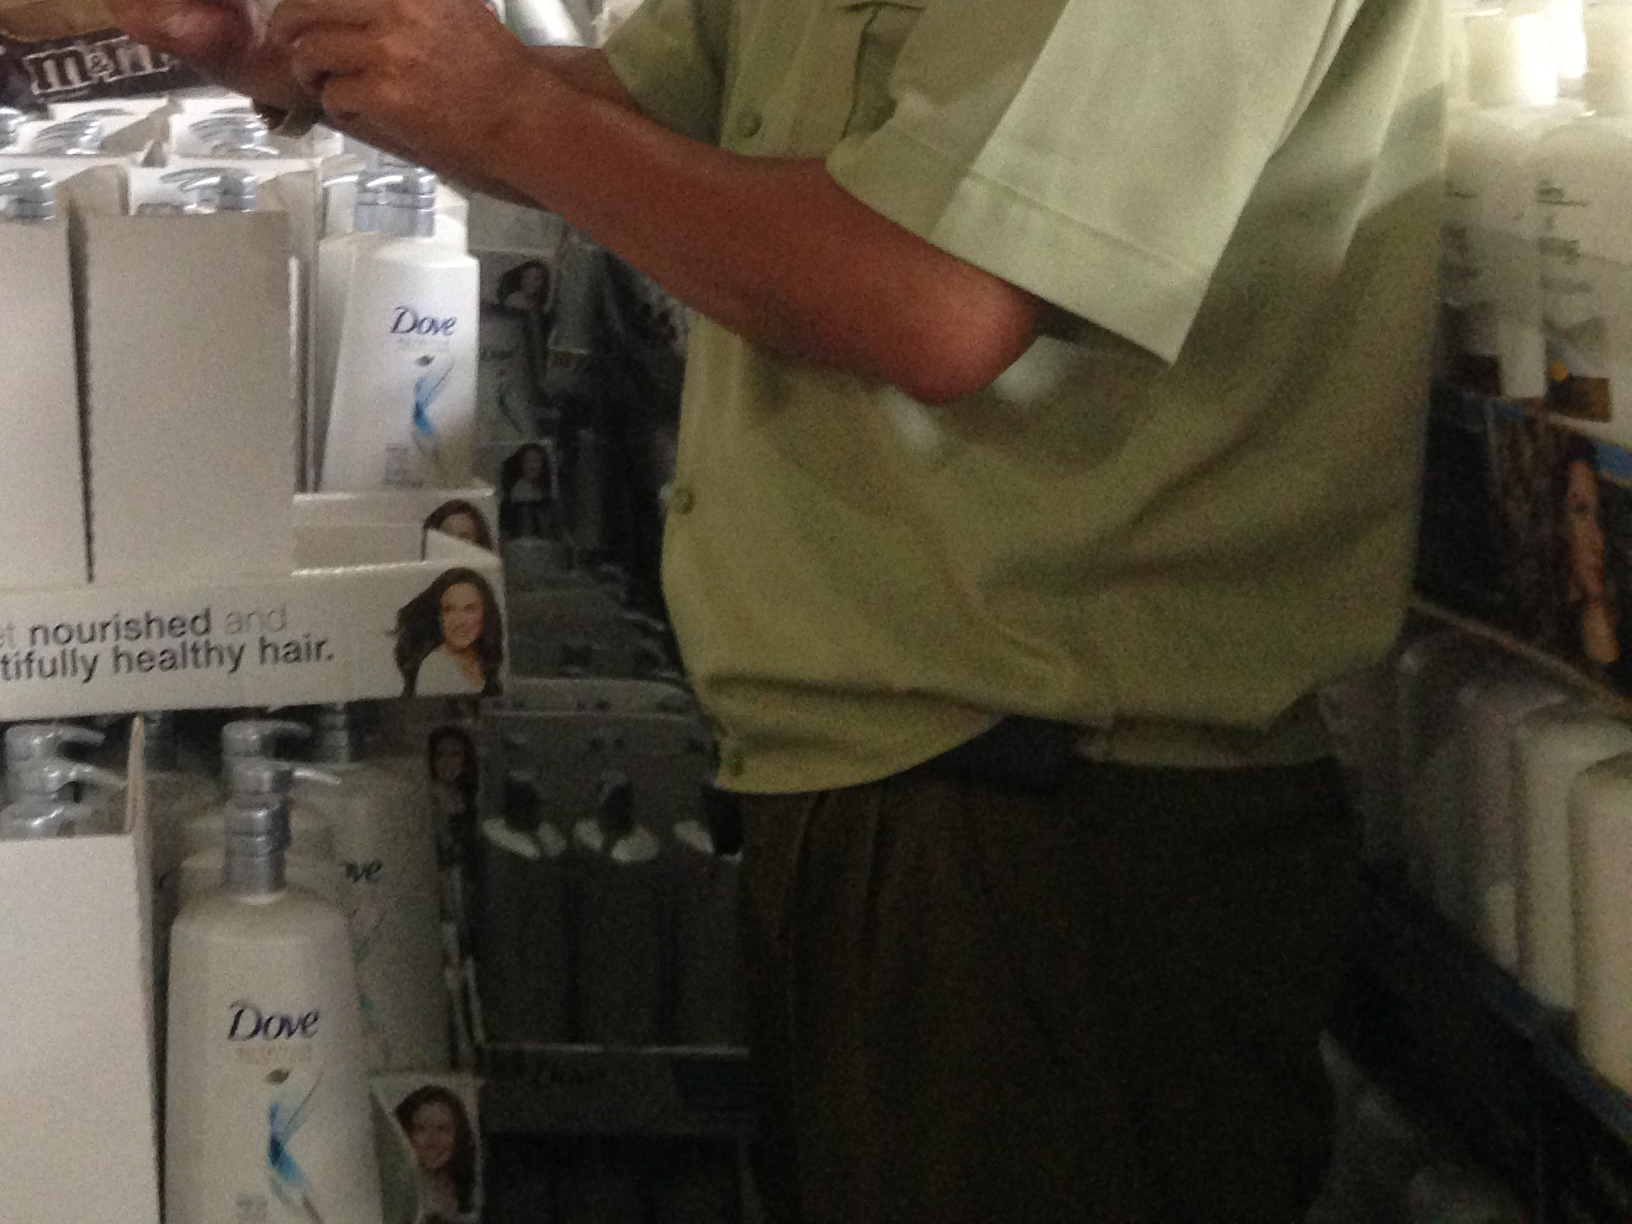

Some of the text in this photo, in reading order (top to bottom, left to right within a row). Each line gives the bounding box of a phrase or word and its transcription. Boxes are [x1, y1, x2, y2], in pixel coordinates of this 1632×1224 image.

[390, 305, 458, 337] Dove
[28, 607, 212, 648] nourished
[224, 604, 287, 637] and
[112, 639, 245, 674] healthy
[256, 635, 335, 668] hair.
[227, 997, 320, 1042] Dove
